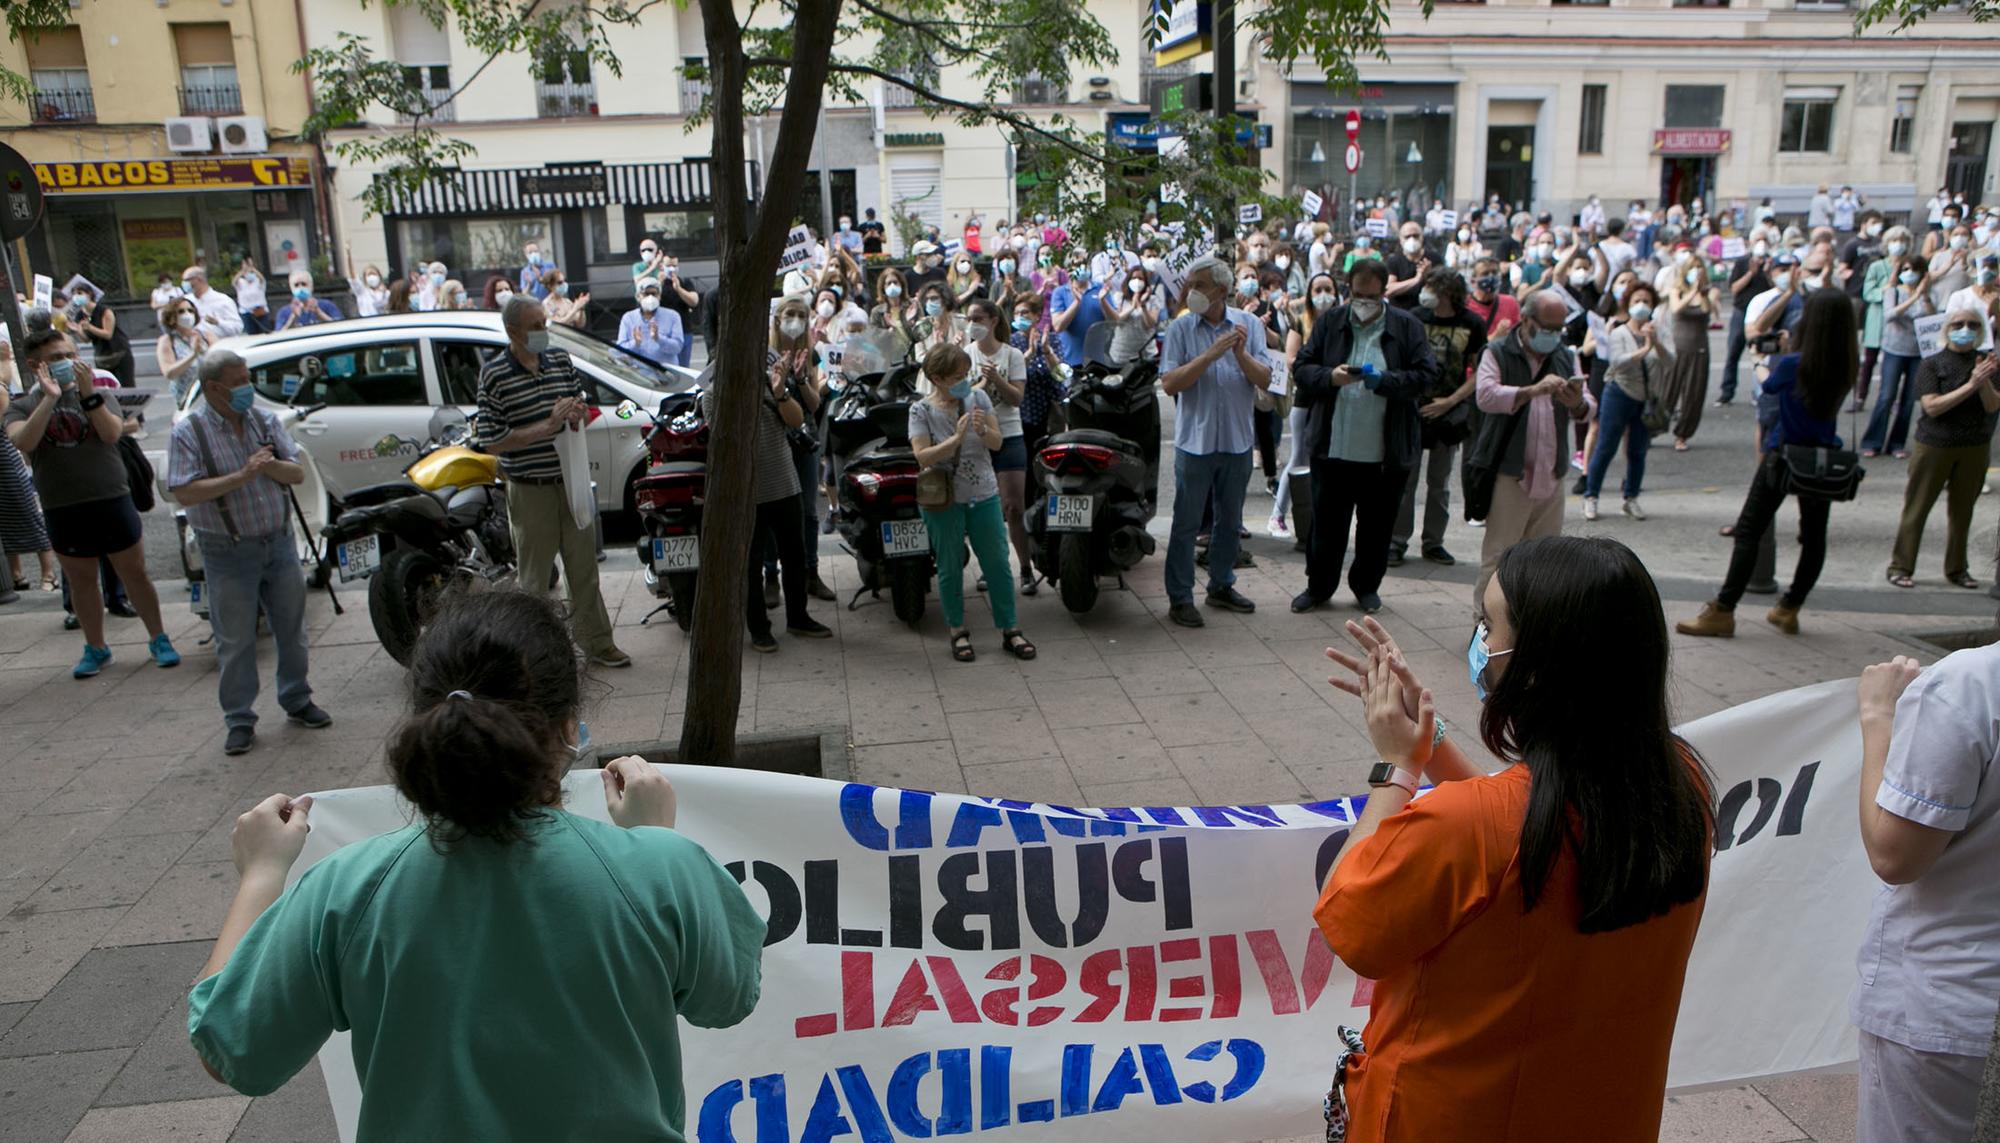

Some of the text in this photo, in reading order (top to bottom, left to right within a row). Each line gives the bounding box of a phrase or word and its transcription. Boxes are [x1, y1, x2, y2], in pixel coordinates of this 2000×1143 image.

[1161, 84, 1184, 112] LIBRE
[35, 161, 169, 187] ABACOS
[340, 448, 376, 461] FREE
[1060, 497, 1089, 511] 5100
[1058, 511, 1082, 525] HRN
[893, 521, 926, 536] 0632
[347, 536, 377, 558] 5638
[664, 537, 697, 553] 0777
[894, 535, 919, 550] HVC
[668, 552, 693, 567] KCY
